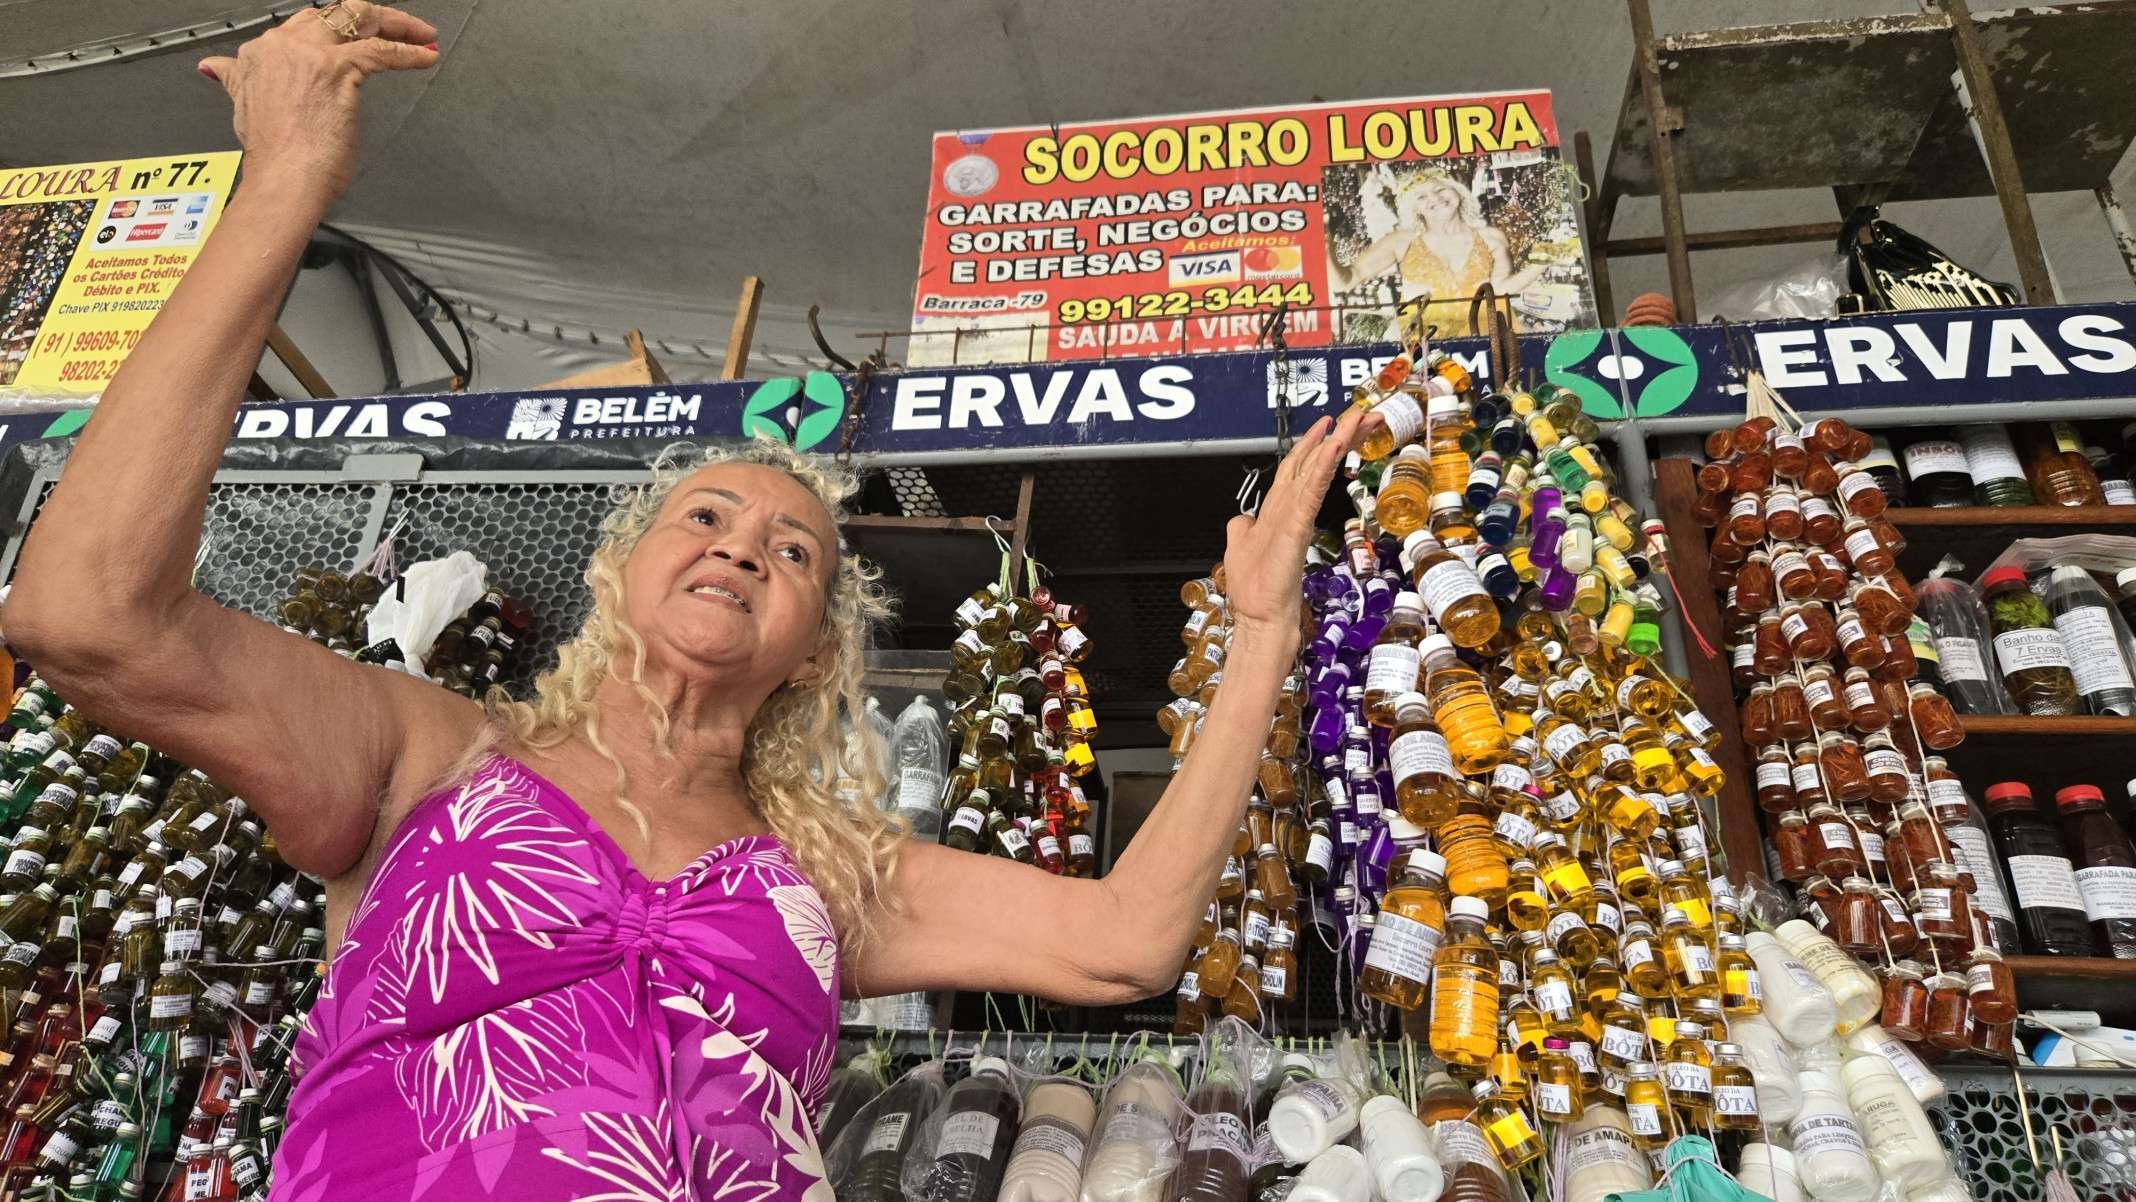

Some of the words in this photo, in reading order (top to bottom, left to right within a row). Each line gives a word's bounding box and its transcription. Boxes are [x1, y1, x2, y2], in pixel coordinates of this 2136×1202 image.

[1022, 119, 1310, 186] SOCORRO
[1328, 102, 1547, 163] LOURA
[167, 160, 211, 188] 77.
[938, 190, 1191, 226] GARRAFADAS
[1203, 182, 1318, 209] PARA:
[948, 226, 1087, 254] SORTE,
[1097, 209, 1307, 247] NEGÓCIOS
[85, 257, 149, 269] Aceitamos
[152, 254, 188, 266] Todos
[951, 260, 977, 285] E
[987, 250, 1163, 283] DEFESAS
[1180, 259, 1232, 277] VISA
[73, 274, 87, 283] os
[90, 269, 137, 282] Cartões
[83, 283, 123, 297] Débito
[125, 286, 134, 295] e
[58, 301, 90, 315] Chave
[91, 301, 112, 313] PIX
[923, 296, 1005, 310] Barraca
[1011, 293, 1044, 306] -79
[1058, 281, 1314, 324] 99122-3444
[1754, 314, 2136, 389] ERVAS
[573, 391, 702, 425] BELÉM
[891, 365, 1196, 431] ERVAS
[234, 401, 451, 438] RVAS
[569, 425, 696, 440] PREFEITURA
[2003, 633, 2043, 648] Banho
[1809, 1118, 1823, 1130] DE
